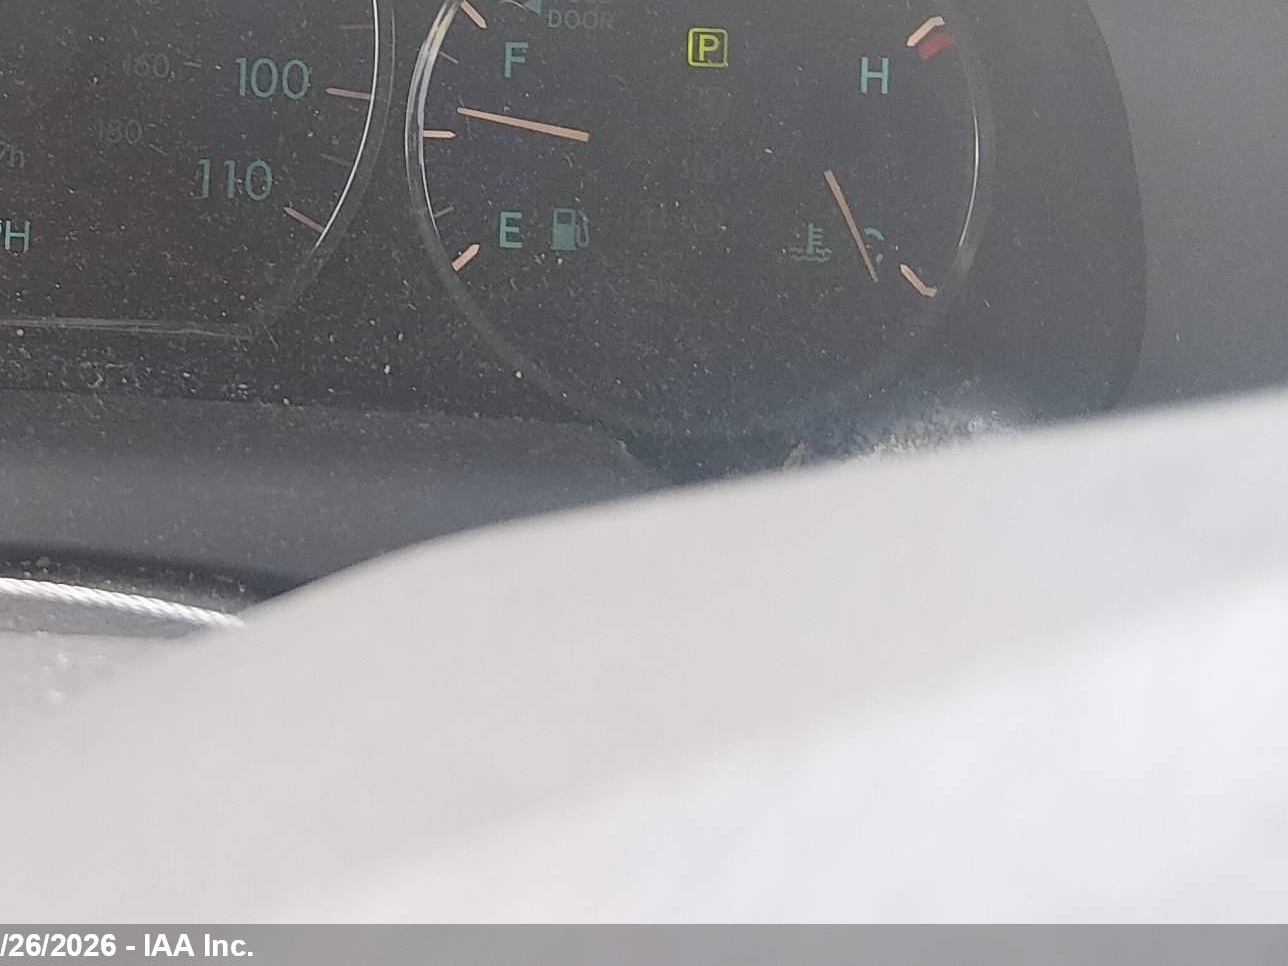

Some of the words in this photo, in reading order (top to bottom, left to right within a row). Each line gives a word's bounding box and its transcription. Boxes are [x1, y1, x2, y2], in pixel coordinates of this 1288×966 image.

[548, 9, 613, 30] DOOR
[235, 57, 310, 99] 100
[504, 42, 529, 78] F
[860, 56, 889, 94] H
[198, 158, 274, 201] 110
[500, 212, 523, 248] E
